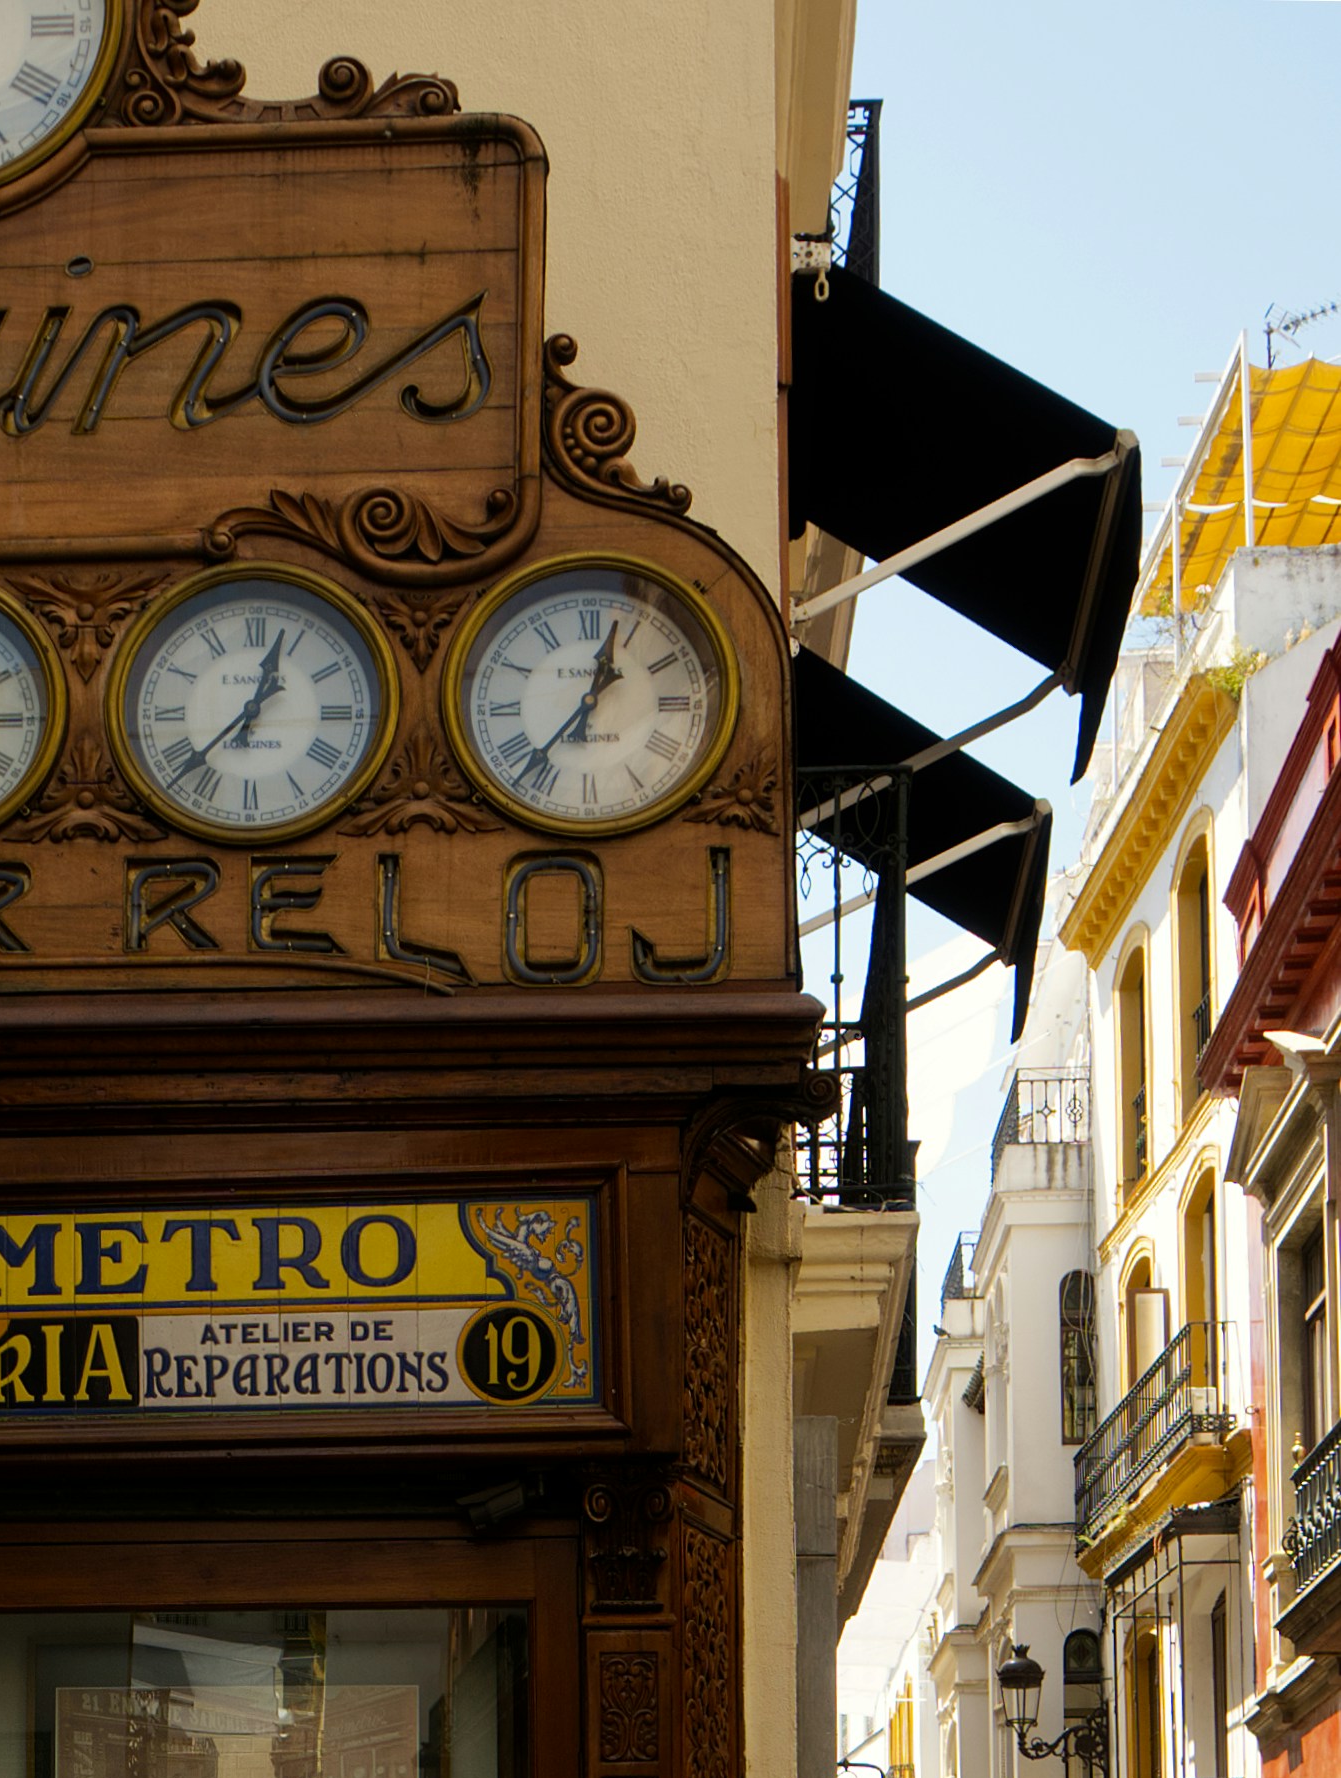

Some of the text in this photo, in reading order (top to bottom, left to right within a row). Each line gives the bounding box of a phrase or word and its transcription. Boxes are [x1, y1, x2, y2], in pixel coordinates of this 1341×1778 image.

[233, 675, 287, 684] SANIS
[568, 668, 623, 678] SANS
[223, 740, 281, 750] LOGINES
[560, 733, 620, 743] LOGINES
[123, 846, 732, 986] RELOJ
[200, 1319, 394, 1346] ATELIER DE
[483, 1316, 544, 1390] 19
[143, 1348, 450, 1400] REPARATIONS
